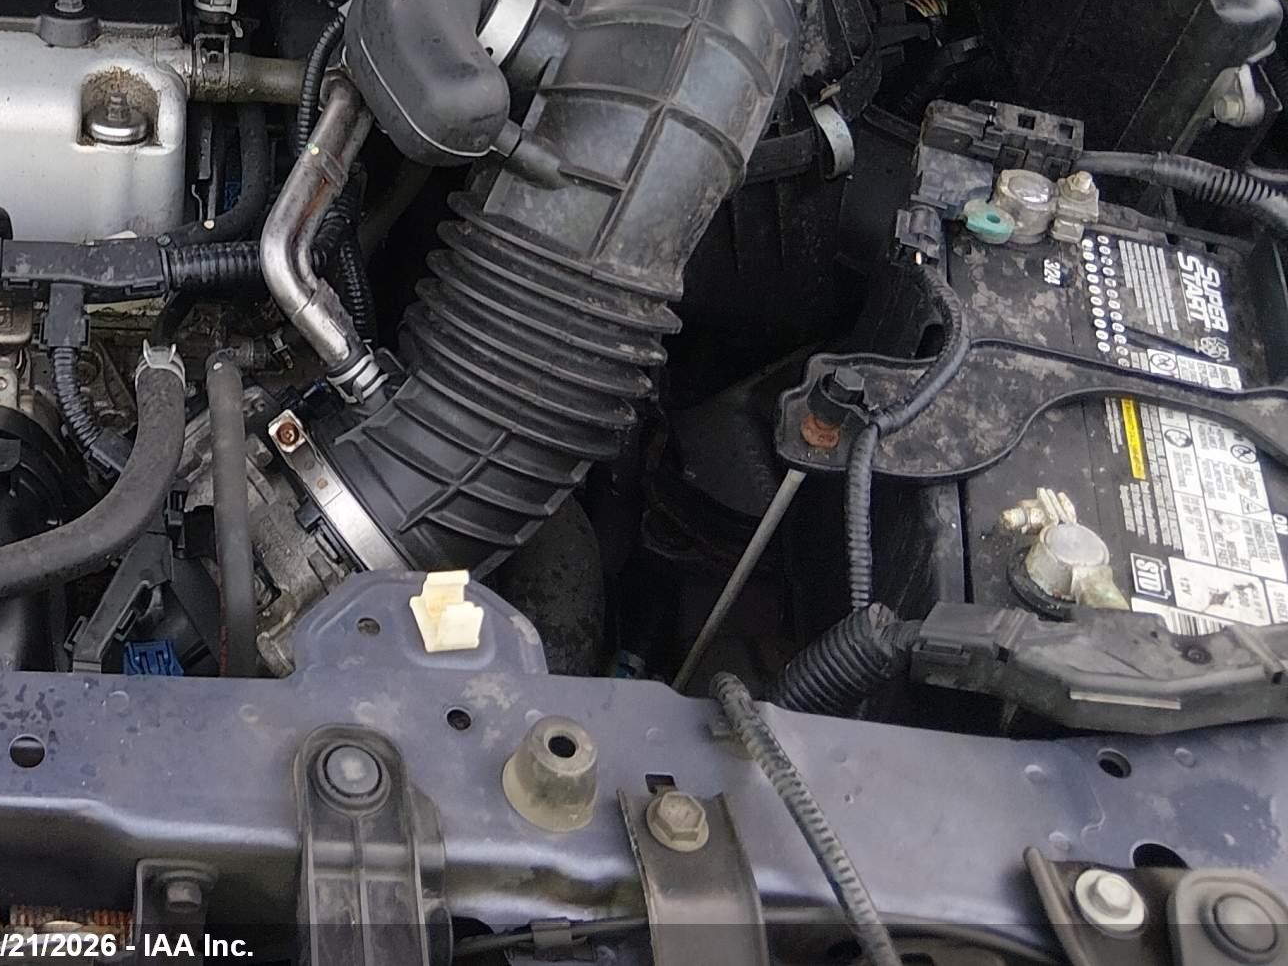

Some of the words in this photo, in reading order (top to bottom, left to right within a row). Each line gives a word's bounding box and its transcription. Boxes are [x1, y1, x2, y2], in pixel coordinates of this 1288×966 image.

[1177, 251, 1212, 332] START
[1200, 264, 1229, 333] SUPER
[1135, 559, 1162, 592] STD
